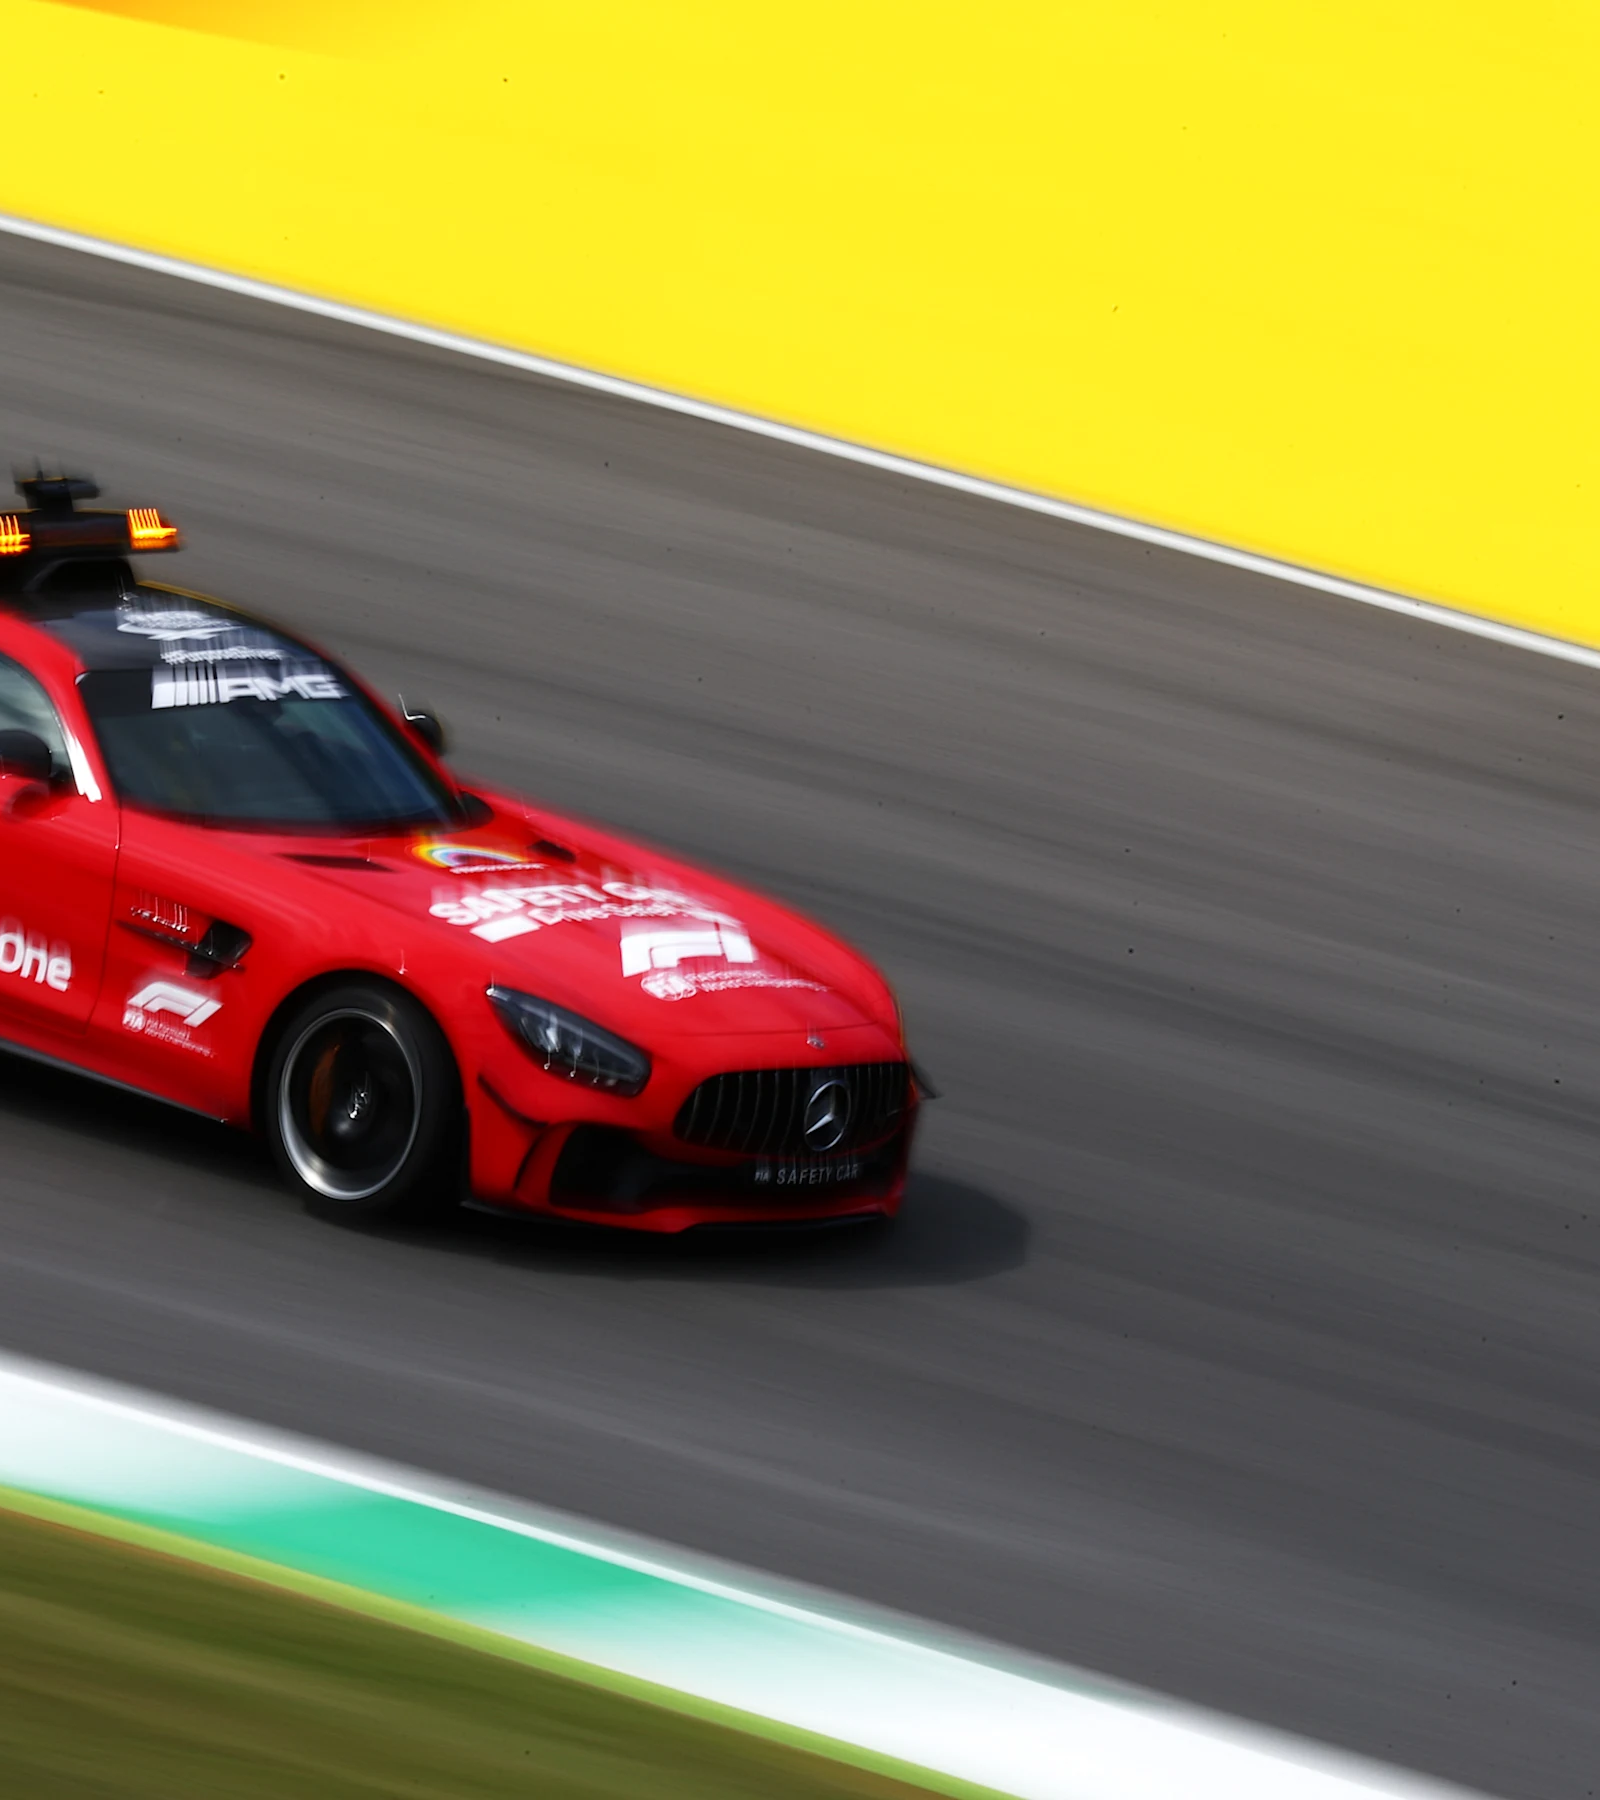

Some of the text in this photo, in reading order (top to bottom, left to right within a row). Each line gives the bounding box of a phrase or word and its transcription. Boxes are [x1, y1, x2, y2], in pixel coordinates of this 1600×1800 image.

[218, 674, 348, 702] AMG
[428, 884, 608, 926] SAFETY
[776, 1167, 832, 1185] SAFETY
[835, 1163, 859, 1182] CAR
